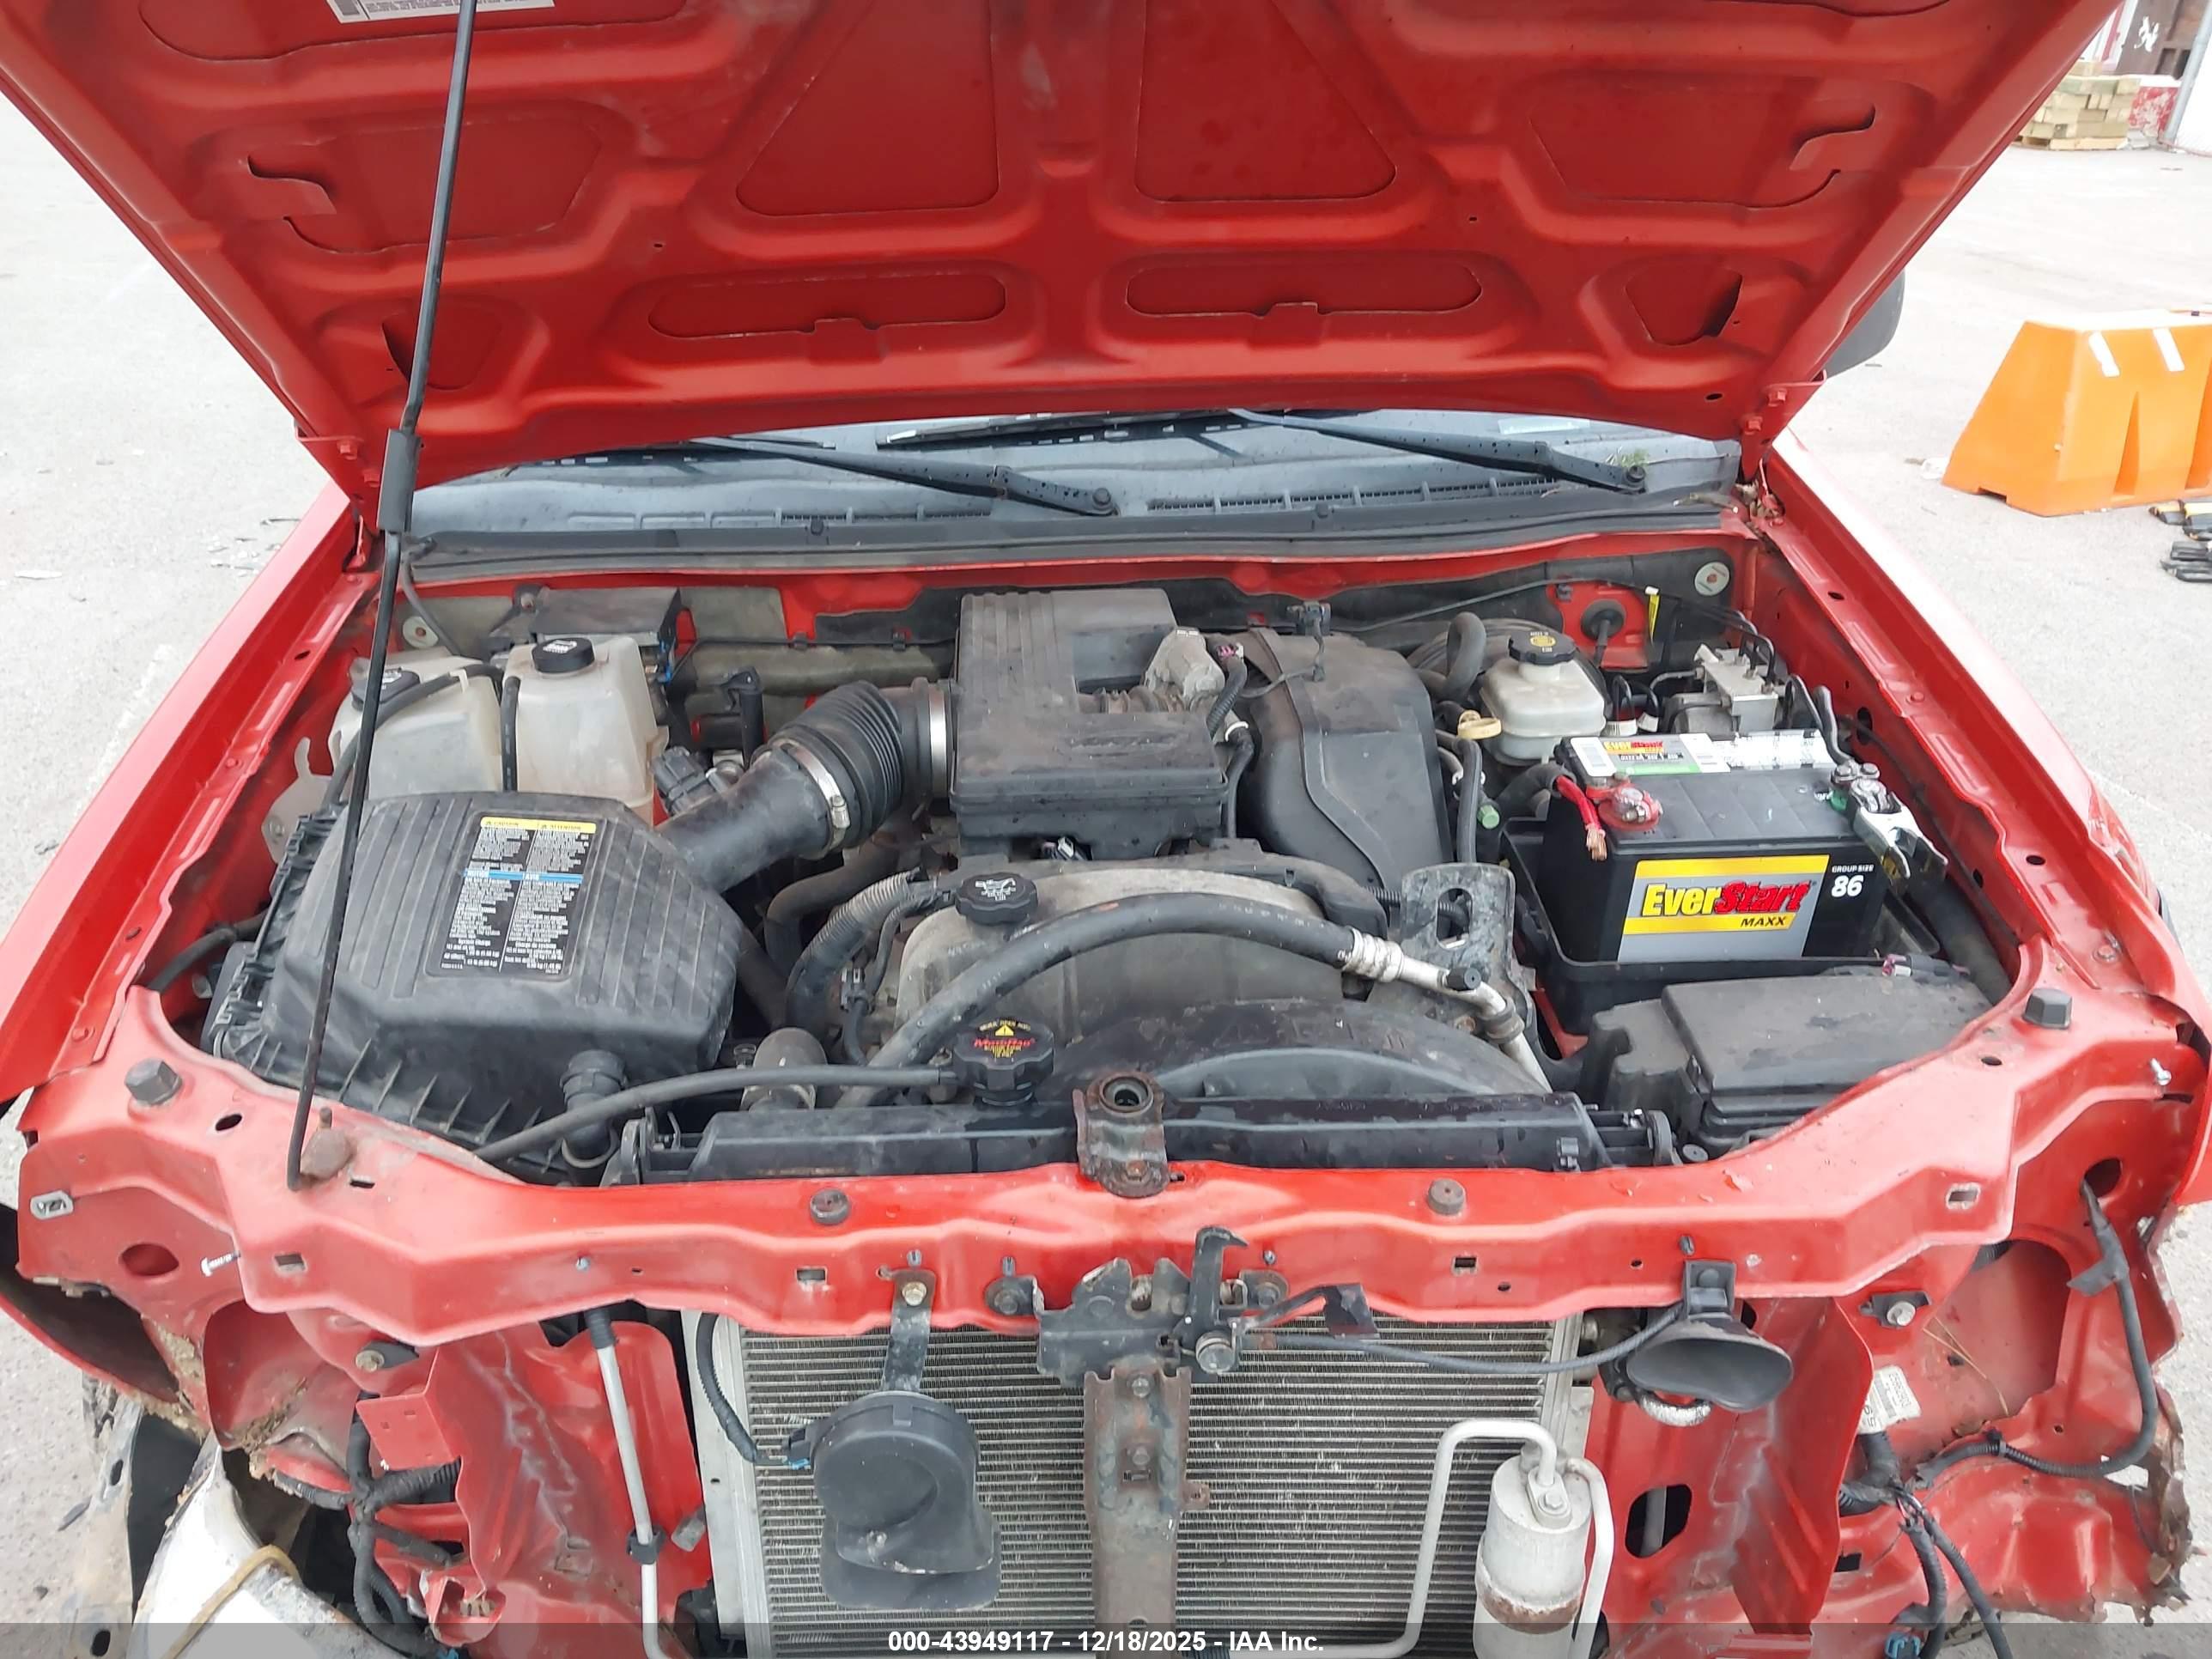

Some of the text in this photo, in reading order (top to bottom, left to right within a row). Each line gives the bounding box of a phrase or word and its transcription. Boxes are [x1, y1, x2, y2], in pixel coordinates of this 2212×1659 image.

[1857, 864, 1874, 872] SIZE
[1831, 874, 1864, 897] 86
[1641, 879, 1811, 917] EverStart
[1741, 916, 1788, 928] MAXX
